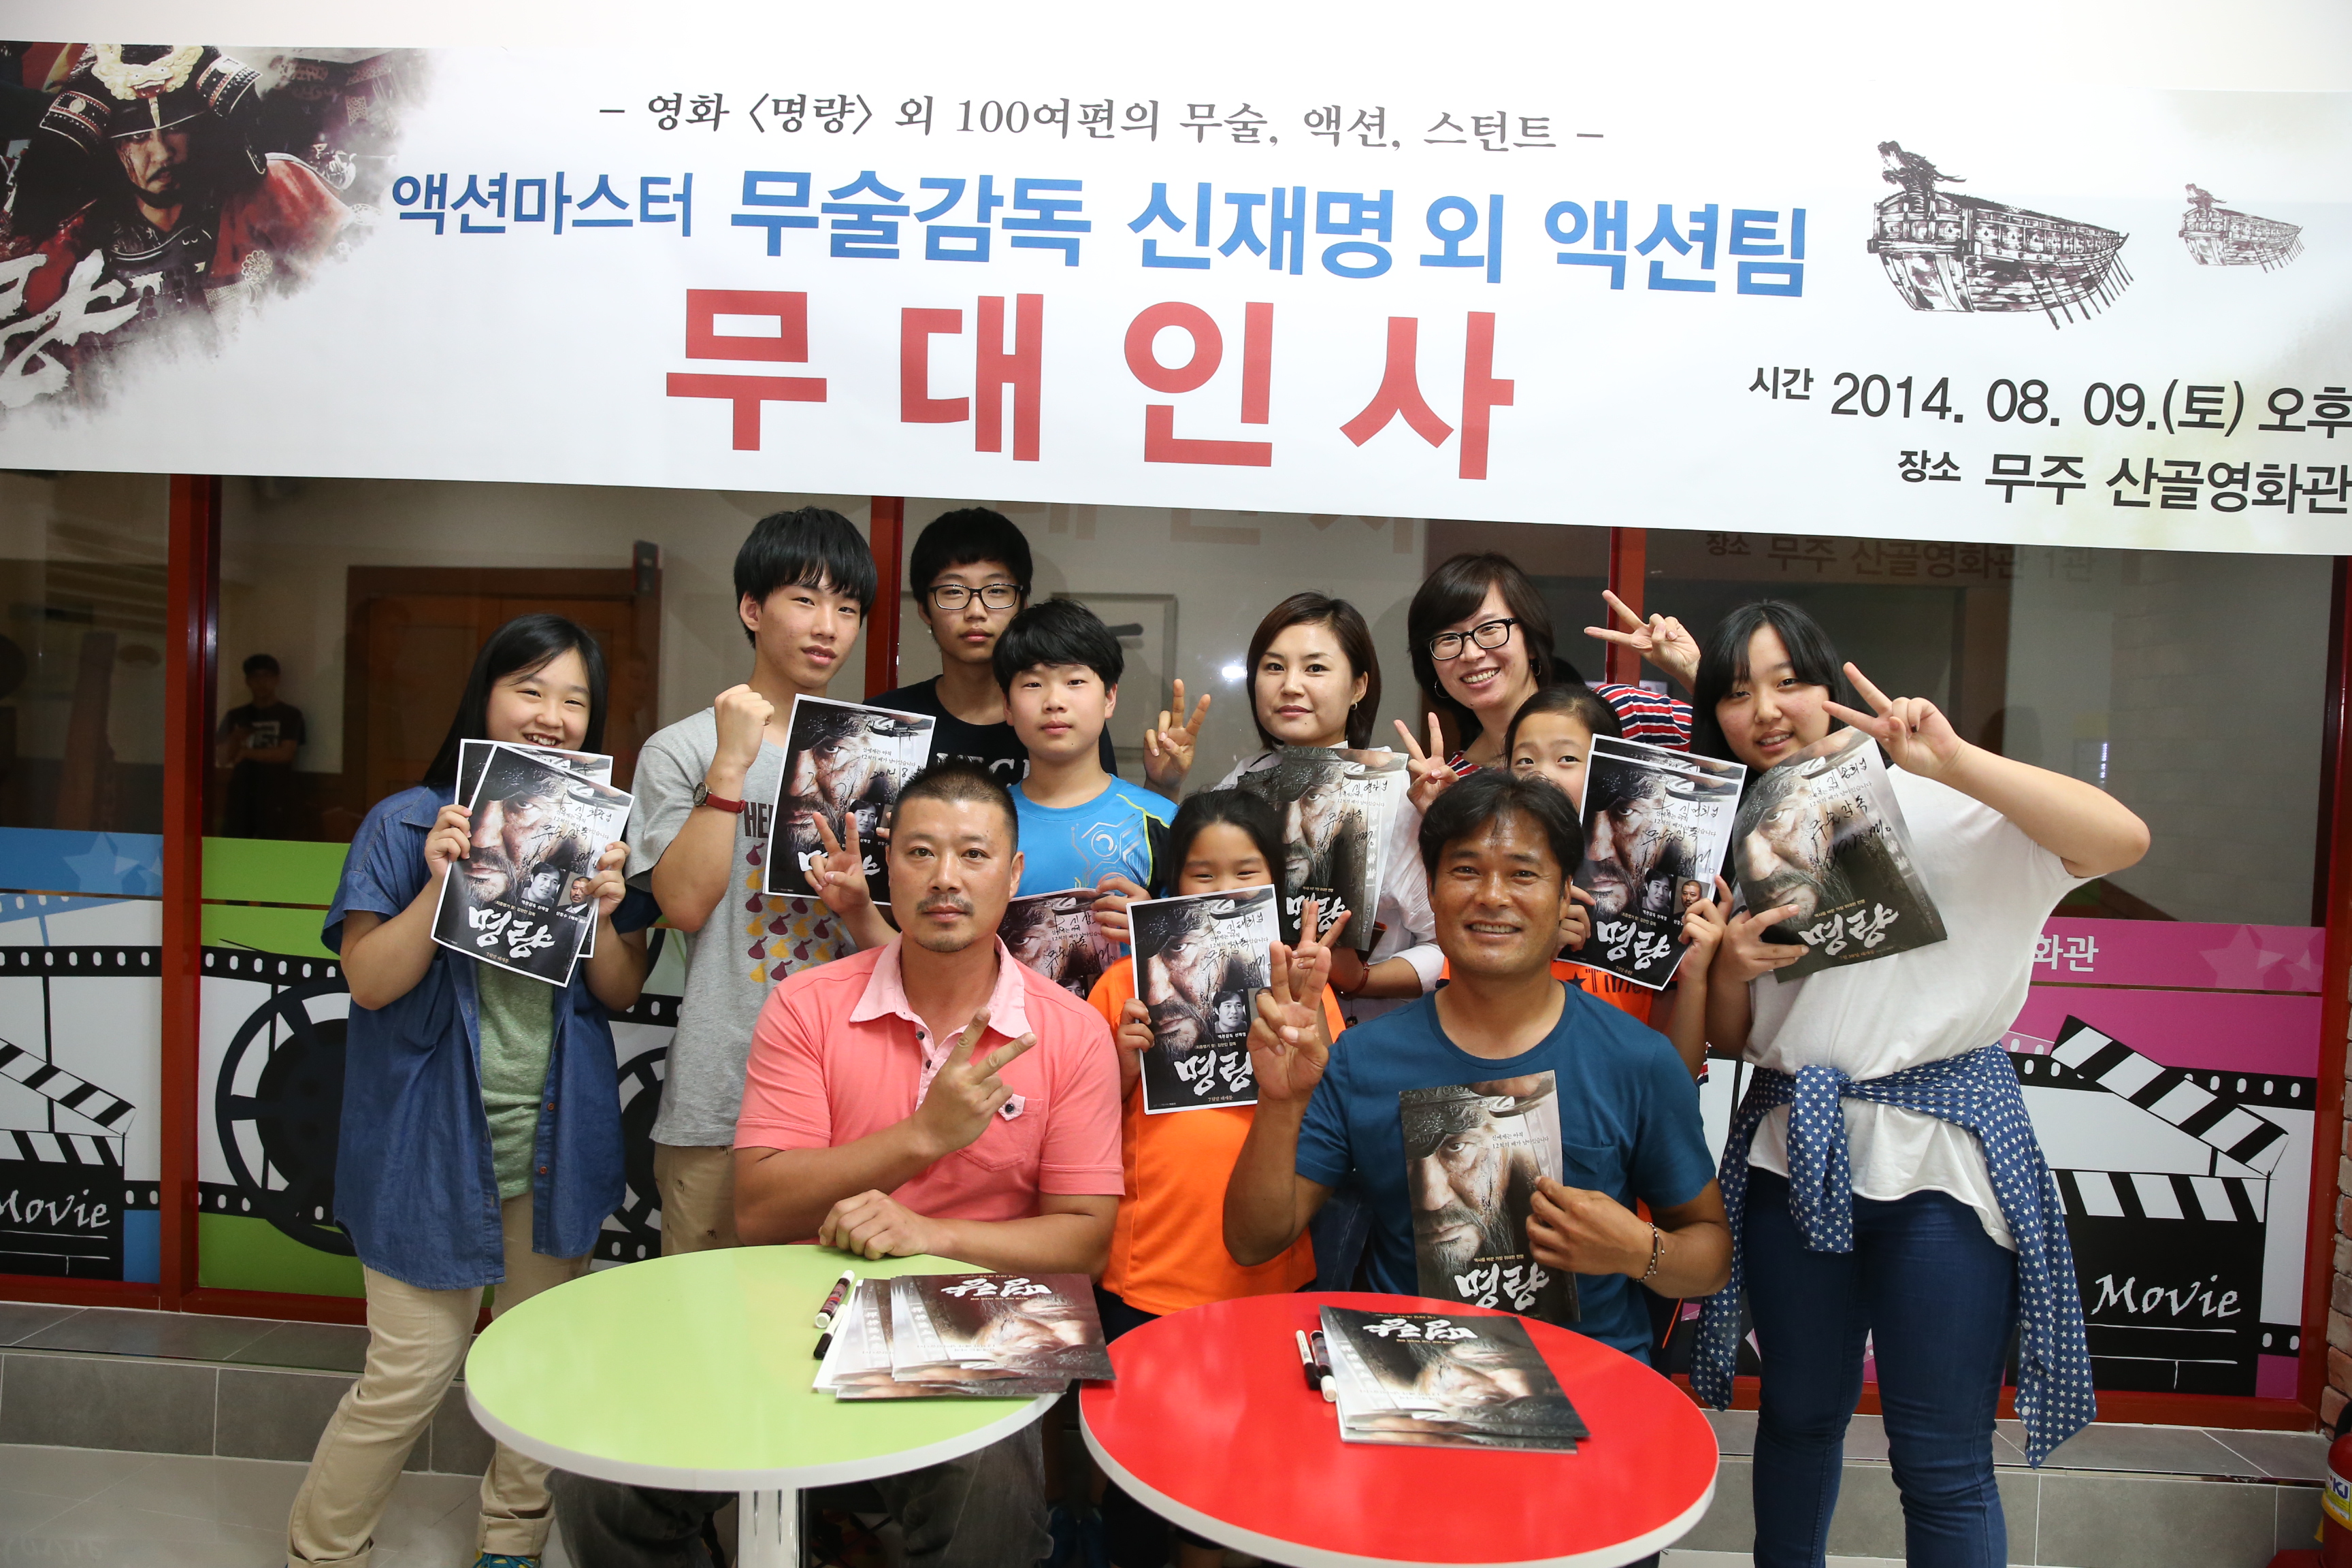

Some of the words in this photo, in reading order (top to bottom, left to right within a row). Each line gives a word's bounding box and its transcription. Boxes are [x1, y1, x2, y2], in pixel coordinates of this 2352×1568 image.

[649, 93, 730, 131] 영화
[896, 96, 932, 135] 외
[958, 98, 1158, 142] 100여편의
[1180, 103, 1277, 146] 무술,
[1305, 105, 1400, 150] 액션,
[1424, 111, 1556, 151] 스턴트
[392, 172, 693, 237] 액션마스터
[731, 171, 1091, 267] 무술감독
[1128, 182, 1393, 278] 신재명
[1420, 195, 1503, 283] 외
[1545, 200, 1806, 297] 액션팀
[1749, 367, 1814, 399] 시간
[1831, 372, 1963, 423] 2014.
[1987, 379, 2059, 426] 08.
[2259, 387, 2352, 438] 오후
[1898, 450, 1961, 483] 장소
[1985, 454, 2086, 505] 무주
[2106, 458, 2352, 514] 산골영화관
[469, 906, 555, 958] 명량
[1597, 921, 1671, 970] 명량
[1798, 902, 1899, 956] 명량
[1454, 1262, 1550, 1311] 명량
[2091, 1274, 2241, 1318] Movie
